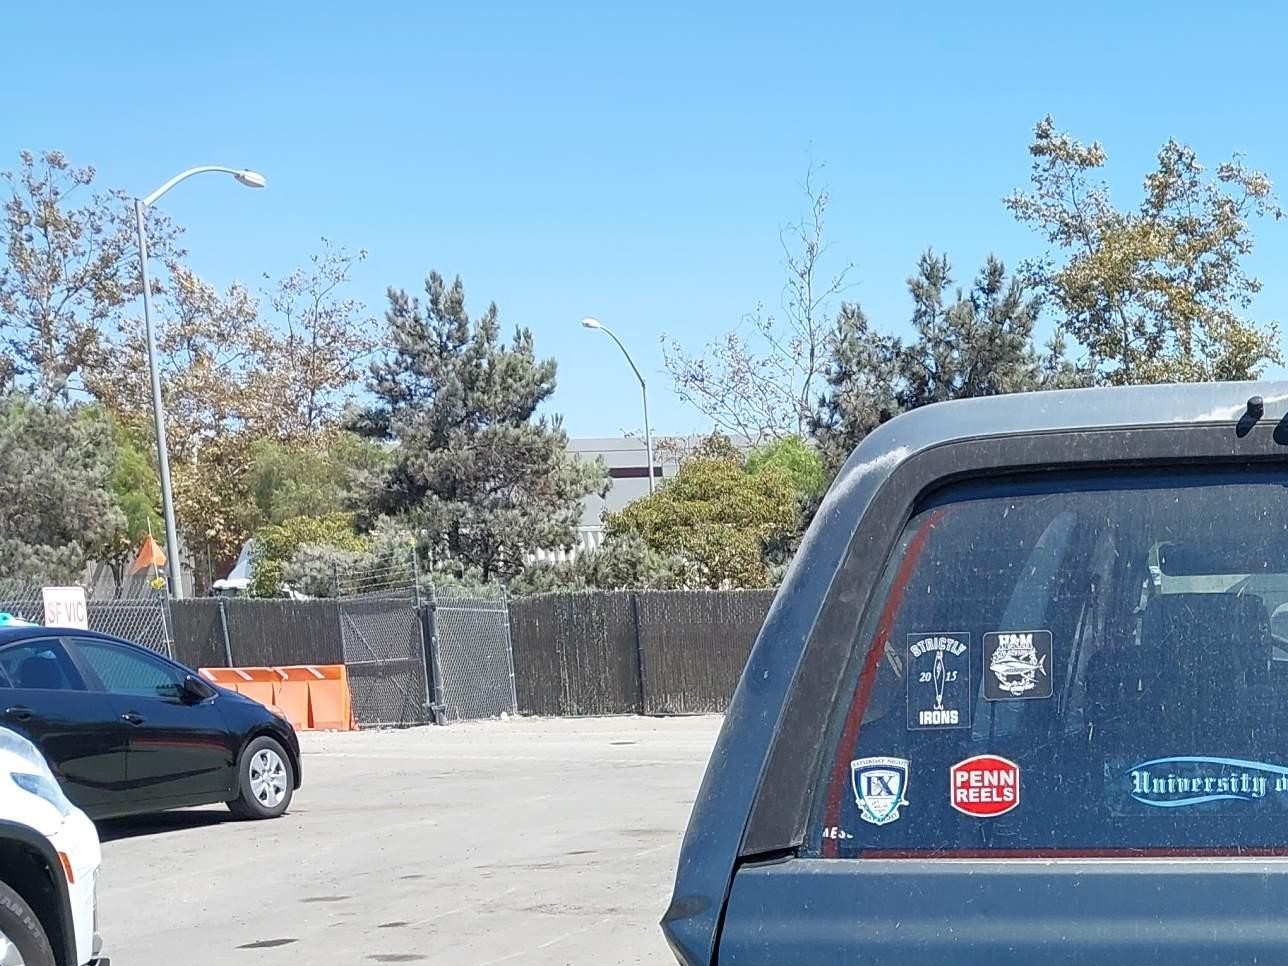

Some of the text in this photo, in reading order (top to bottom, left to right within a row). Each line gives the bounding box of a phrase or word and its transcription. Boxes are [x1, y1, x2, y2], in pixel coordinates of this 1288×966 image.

[910, 637, 967, 658] STRICTLY
[919, 671, 958, 682] 20 15
[919, 710, 959, 725] IRONS
[864, 775, 896, 797] IX
[955, 769, 1015, 787] PENN
[1131, 770, 1268, 798] University
[956, 787, 1014, 803] REELS
